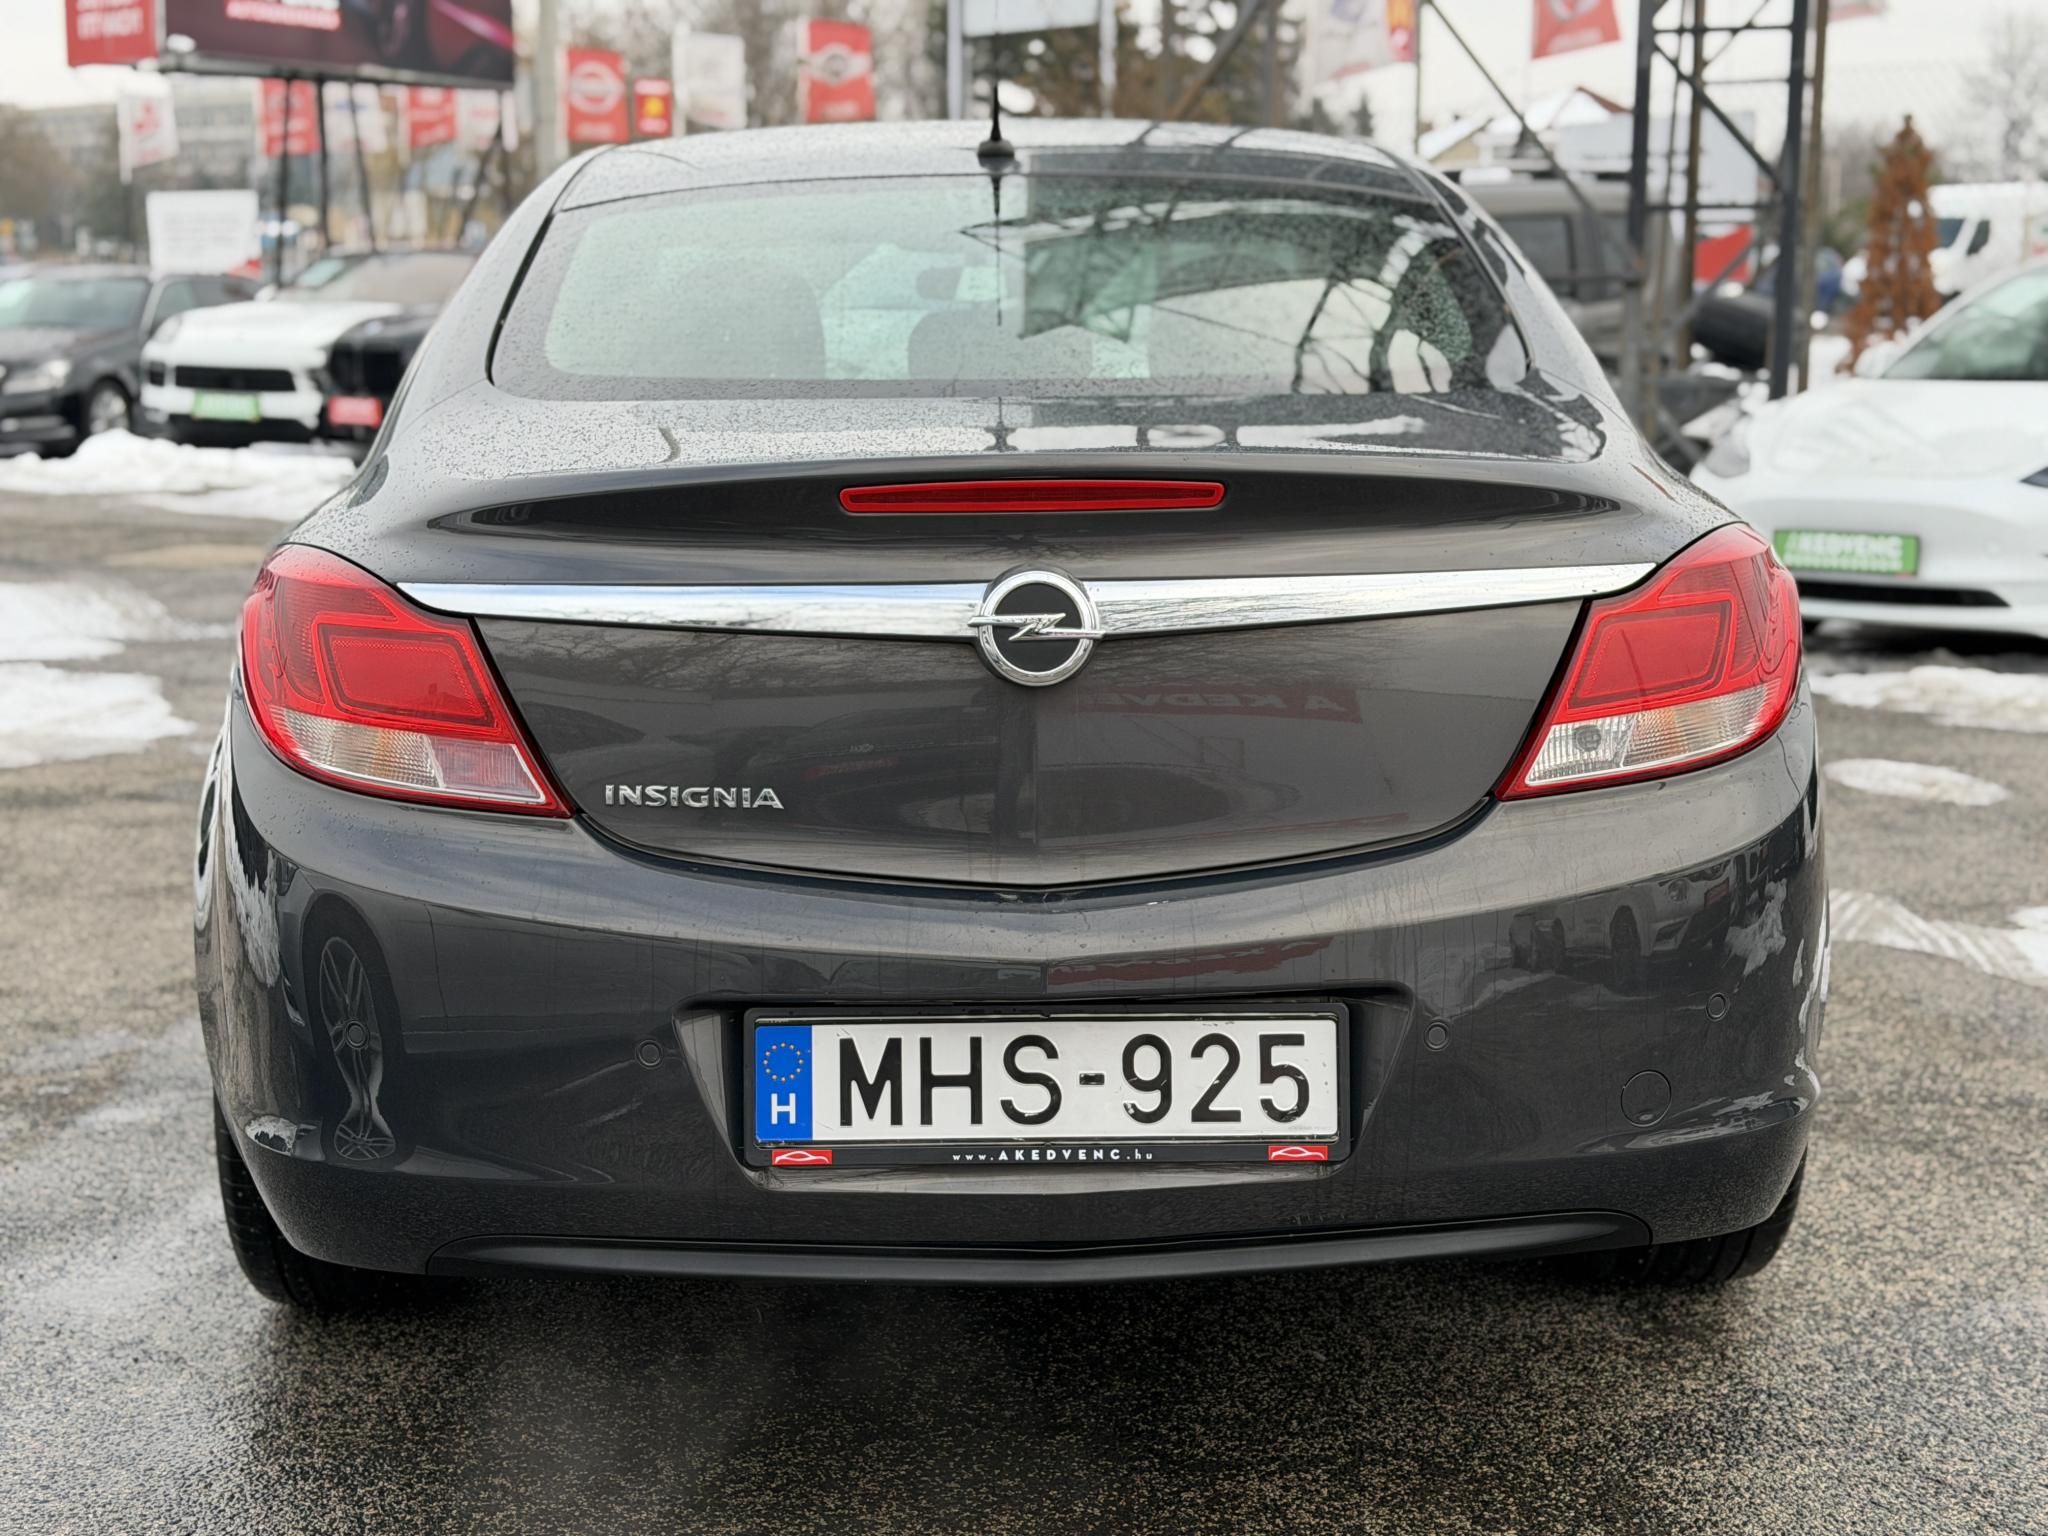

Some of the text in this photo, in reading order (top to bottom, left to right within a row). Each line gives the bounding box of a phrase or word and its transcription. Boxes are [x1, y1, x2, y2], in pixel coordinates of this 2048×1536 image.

[605, 784, 785, 810] INSIGNIA
[839, 1033, 1310, 1127] MHS-925
[771, 1093, 796, 1125] H
[952, 1148, 1154, 1161] www.AKEDVENC.hu
